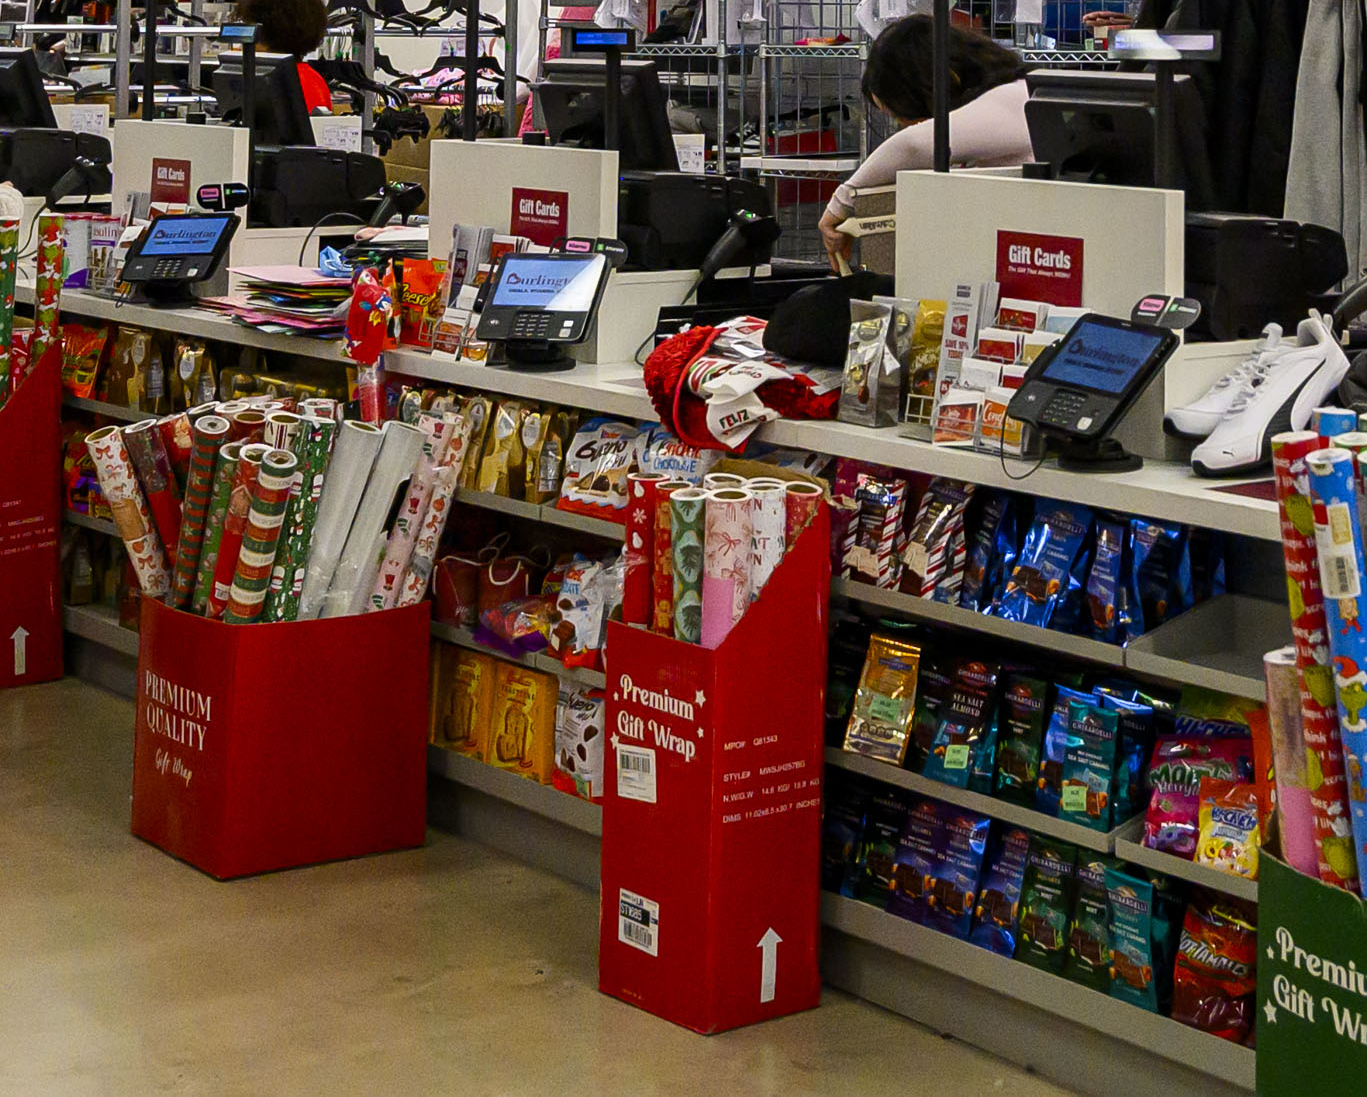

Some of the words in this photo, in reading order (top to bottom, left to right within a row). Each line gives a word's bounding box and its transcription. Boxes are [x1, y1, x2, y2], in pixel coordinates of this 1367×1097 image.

[518, 198, 535, 215] Gift
[535, 199, 561, 218] Cards
[152, 228, 217, 241] Burlington
[1008, 244, 1031, 265] Gift
[1033, 247, 1071, 270] Cards
[505, 272, 572, 289] Burlingt
[944, 338, 957, 350] SAVE
[1068, 339, 1141, 368] Burlington
[718, 408, 750, 430] FELIZ
[145, 669, 212, 722] PREMIUM
[619, 673, 694, 721] Premium
[951, 703, 981, 718] ALMOND
[146, 702, 207, 752] QUALITY
[616, 709, 645, 741] Gift
[648, 718, 697, 763] Wrap
[1071, 720, 1114, 740] GHIRARDELLI
[1273, 974, 1316, 1024] Gift
